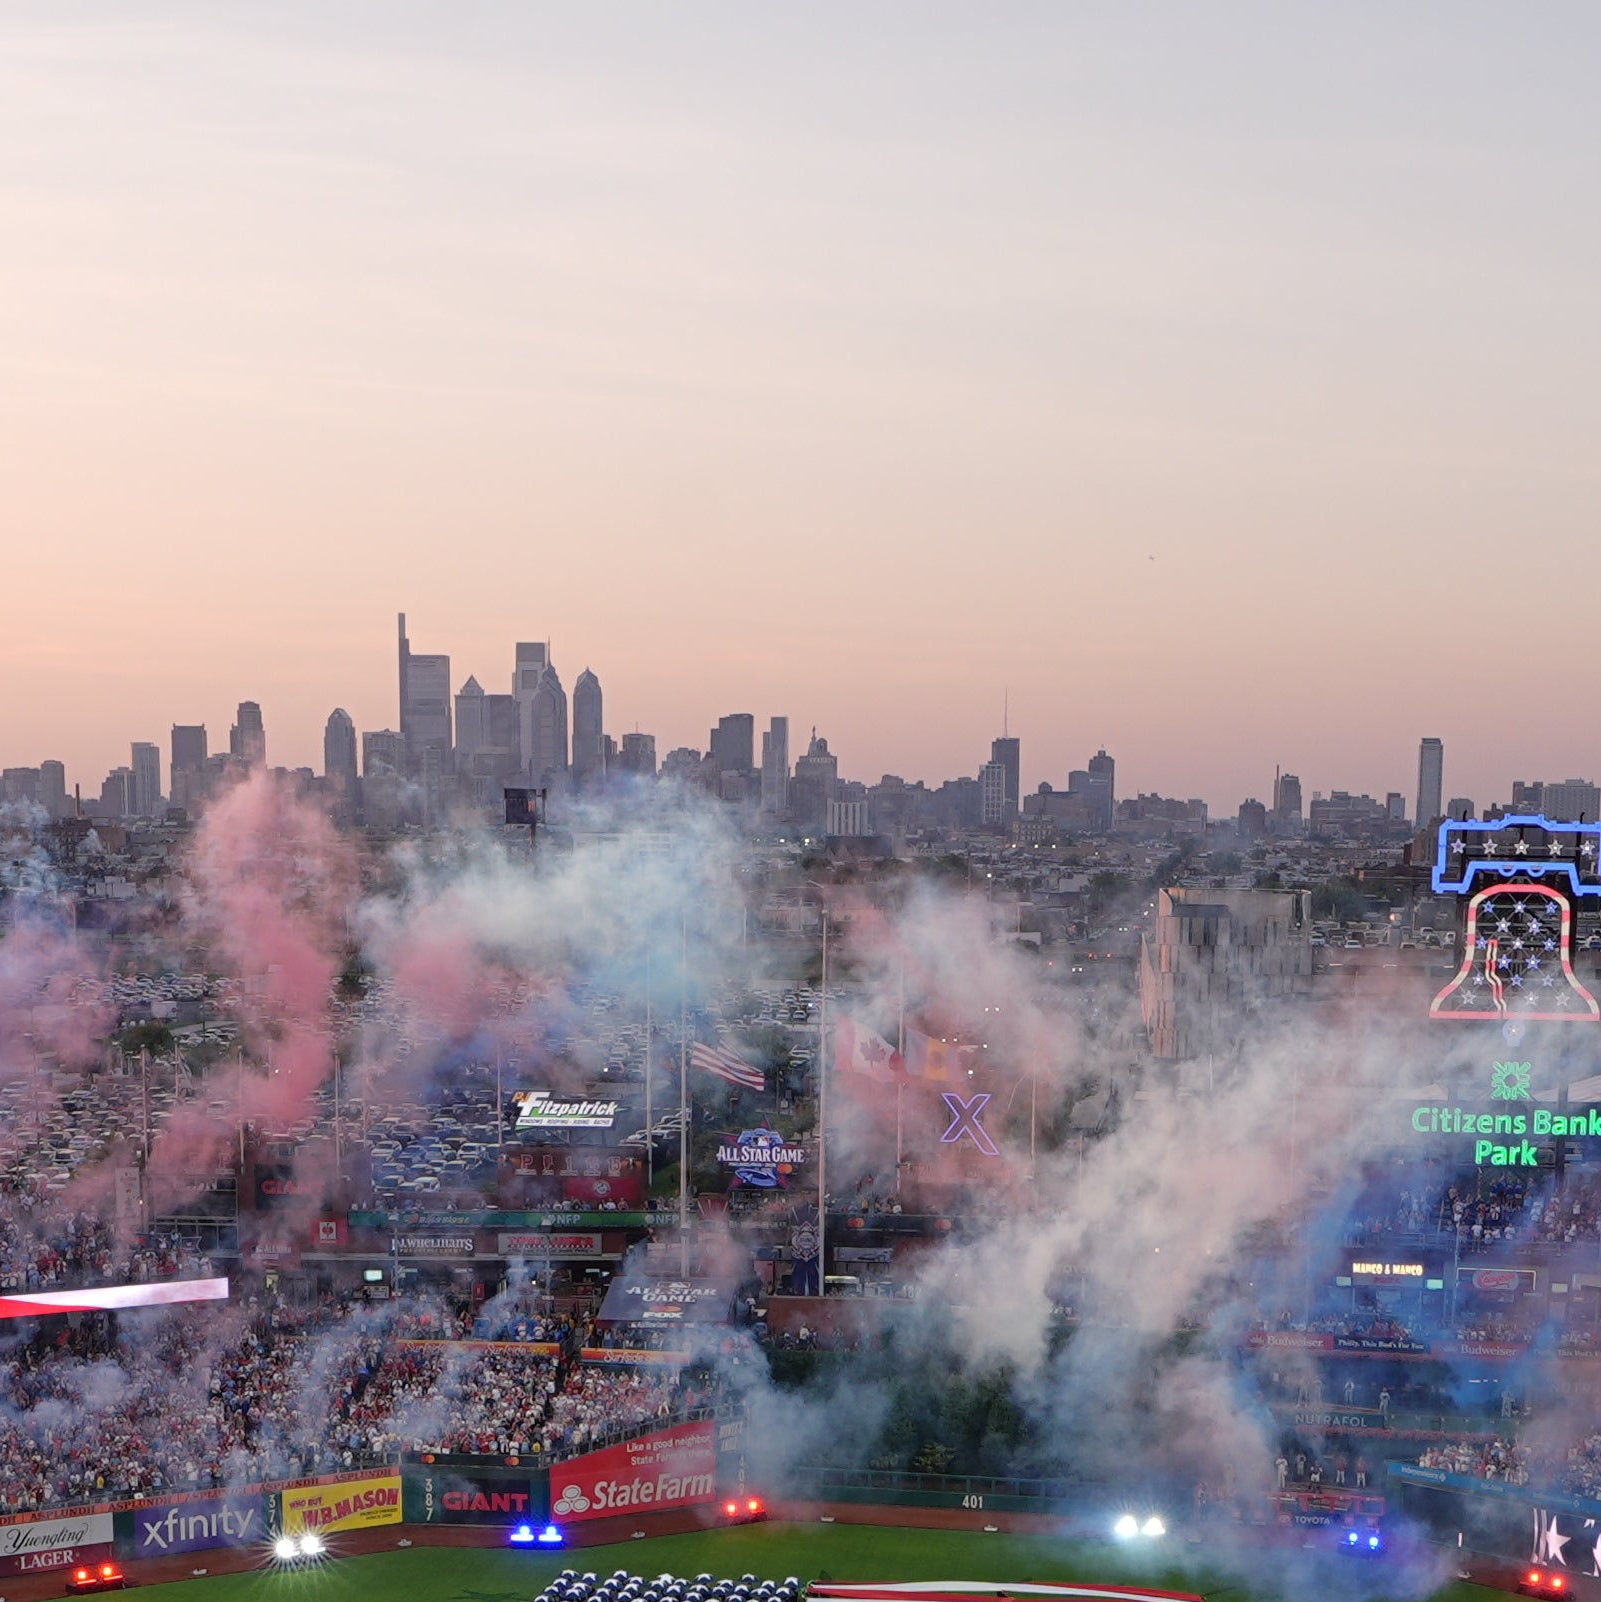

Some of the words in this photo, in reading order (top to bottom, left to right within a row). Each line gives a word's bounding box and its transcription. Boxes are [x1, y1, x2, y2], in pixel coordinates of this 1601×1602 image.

[517, 1091, 618, 1117] Fitzpatrick
[1411, 1107, 1527, 1135] Citizens
[716, 1145, 741, 1162] ALL
[741, 1145, 771, 1163] STAR
[772, 1146, 805, 1163] GAME
[1475, 1138, 1538, 1166] Park
[556, 1214, 581, 1225] NFP
[656, 1214, 680, 1225] NFP
[626, 1286, 663, 1296] ALL
[665, 1287, 717, 1296] STAR
[642, 1294, 696, 1303] GAME
[643, 1311, 684, 1319] FOX
[1266, 1334, 1324, 1348] Budweiser
[1461, 1343, 1517, 1357] Budweiser
[1295, 1413, 1368, 1428] NUTRAFOL
[626, 1442, 645, 1453] Like
[653, 1438, 673, 1451] good
[631, 1455, 654, 1466] State
[656, 1452, 678, 1463] Farm
[332, 1468, 392, 1485] ASPLUNDH
[259, 1477, 320, 1493] ASPLUNDH
[108, 1496, 171, 1512] ASPLUNDH
[289, 1498, 307, 1509] WHO
[308, 1496, 323, 1507] BUT
[425, 1478, 434, 1522] 387
[441, 1491, 529, 1512] GIANT
[962, 1495, 983, 1509] 401
[30, 1505, 95, 1522] ASPLUNDH
[1295, 1515, 1331, 1526] TOYOTA
[143, 1504, 255, 1549] xfinity
[4, 1522, 90, 1553] Yuengling
[20, 1550, 74, 1571] LAGER
